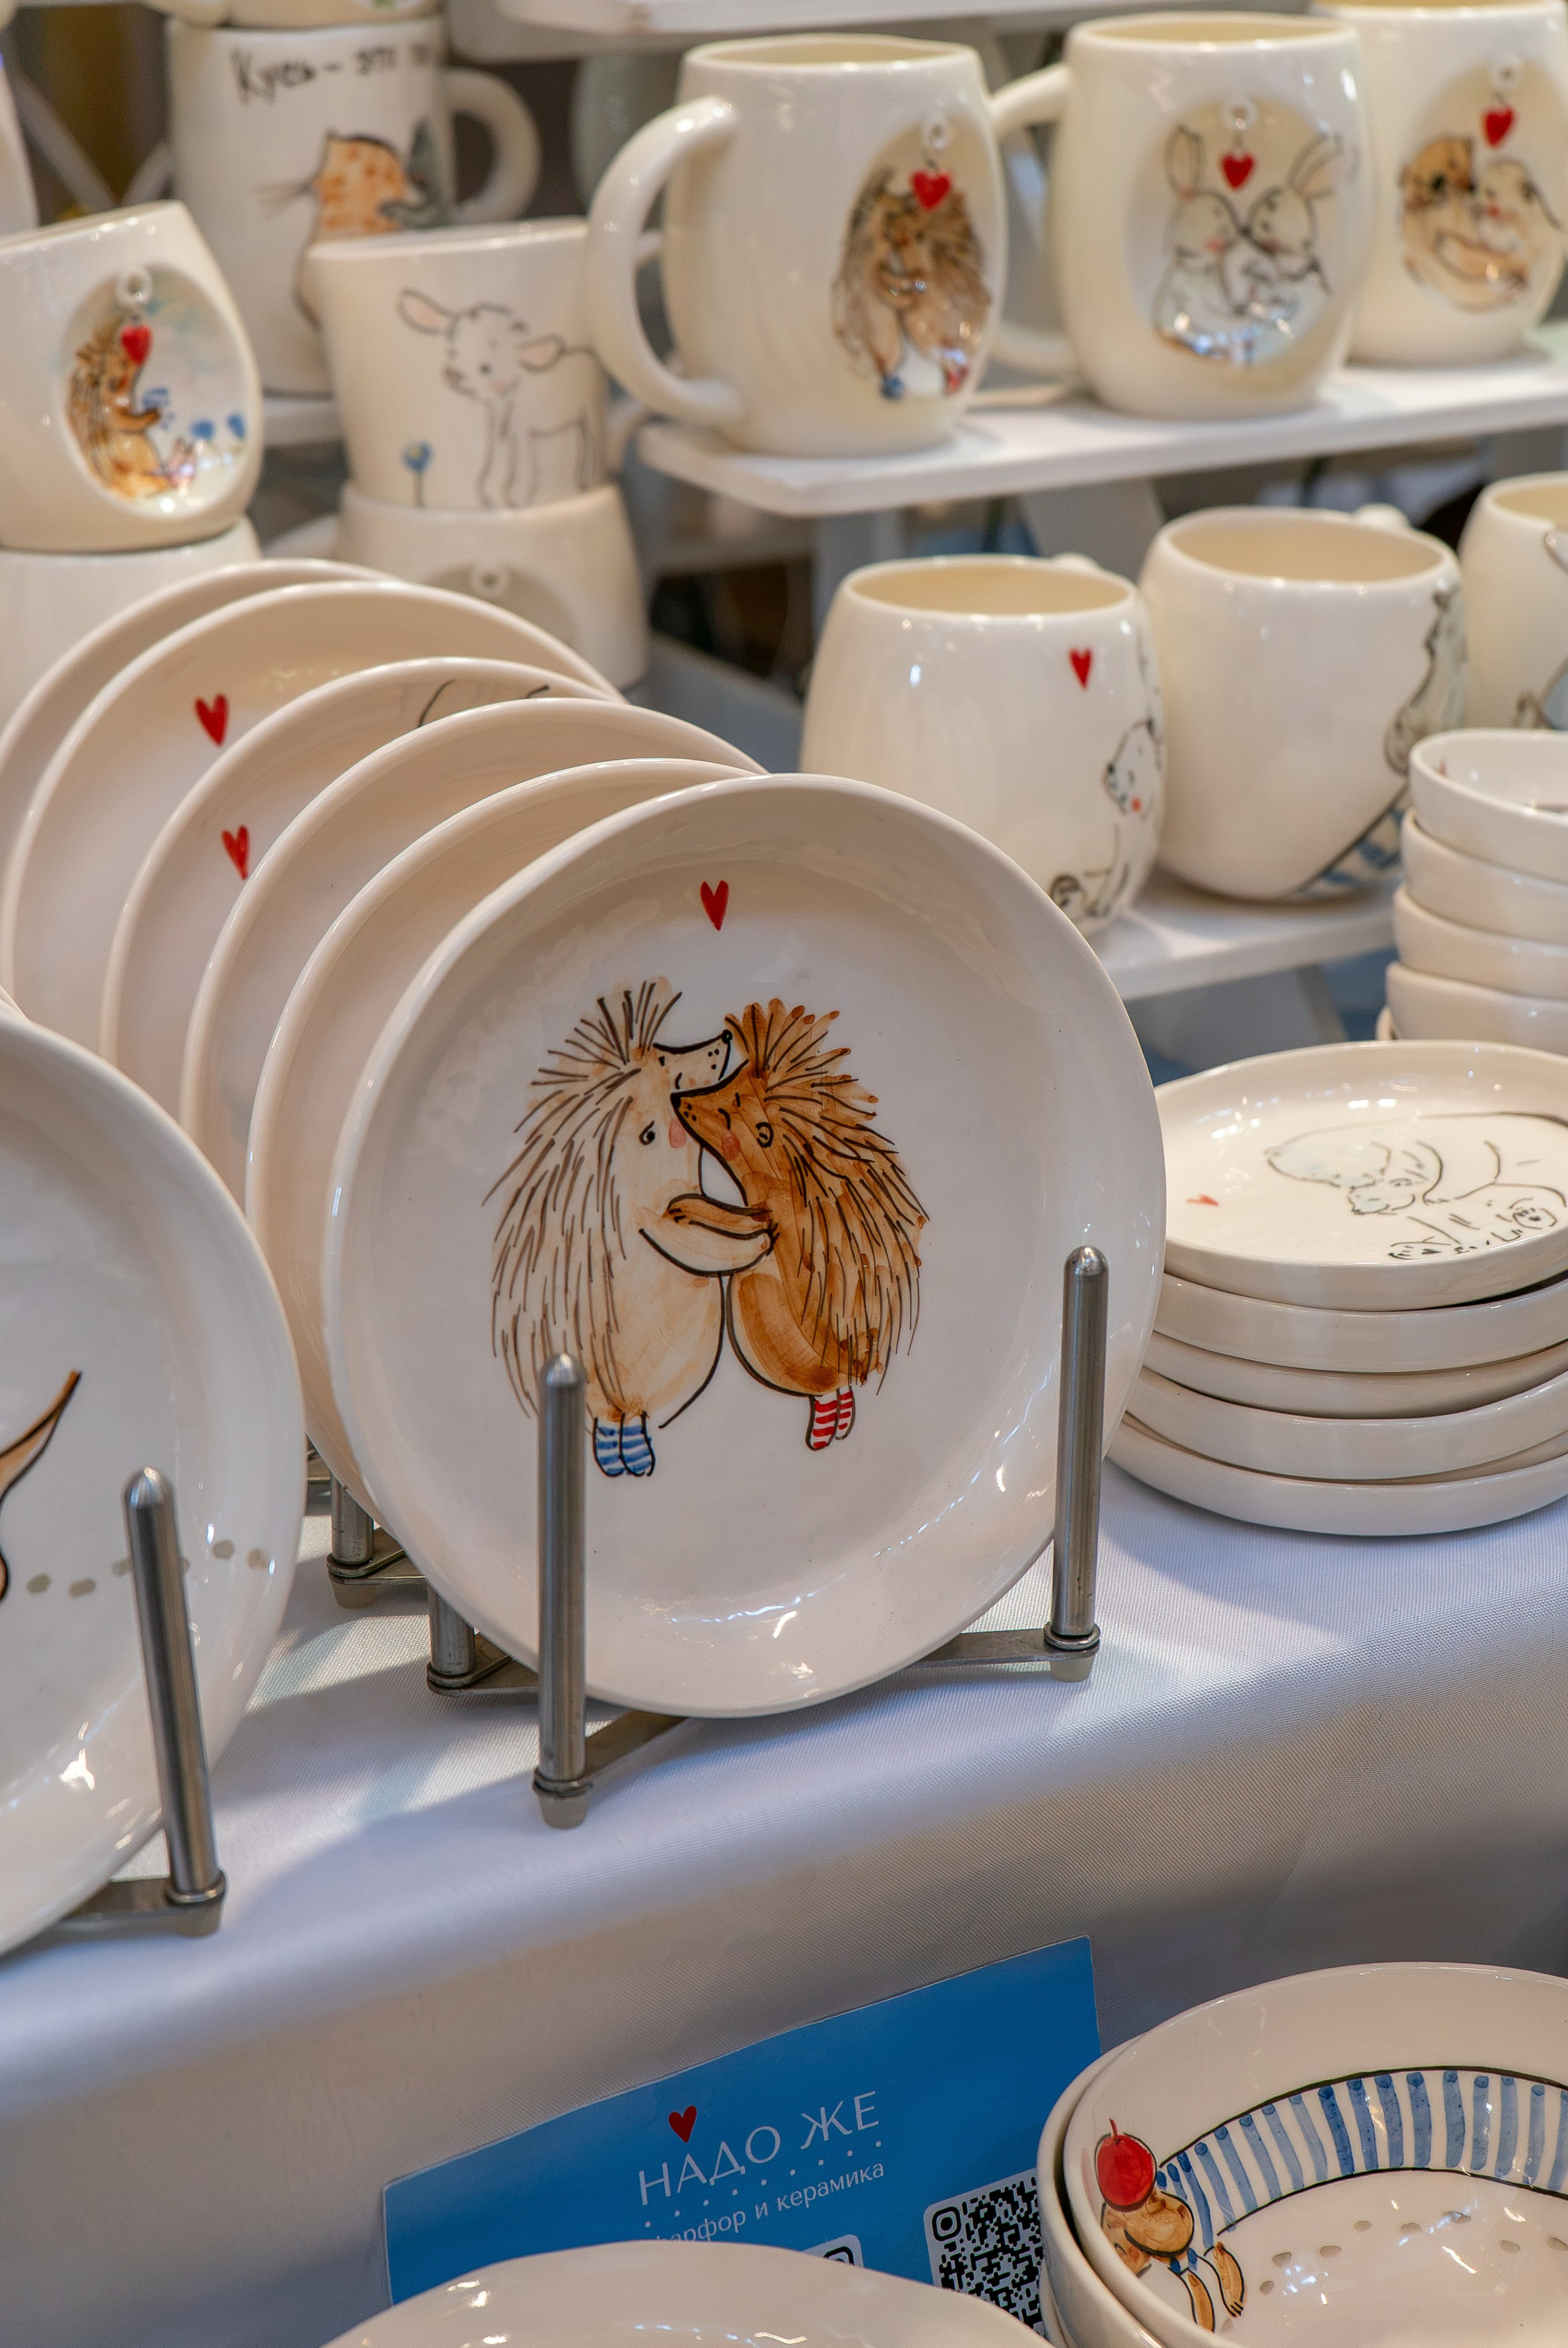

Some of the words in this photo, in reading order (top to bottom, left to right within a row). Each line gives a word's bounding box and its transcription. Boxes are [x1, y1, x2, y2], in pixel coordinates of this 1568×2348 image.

[638, 2126, 781, 2206] НАДО
[800, 2091, 880, 2150] ЖЕ
[656, 2210, 746, 2242] рфор
[755, 2202, 769, 2220] и
[777, 2162, 884, 2212] керамика
